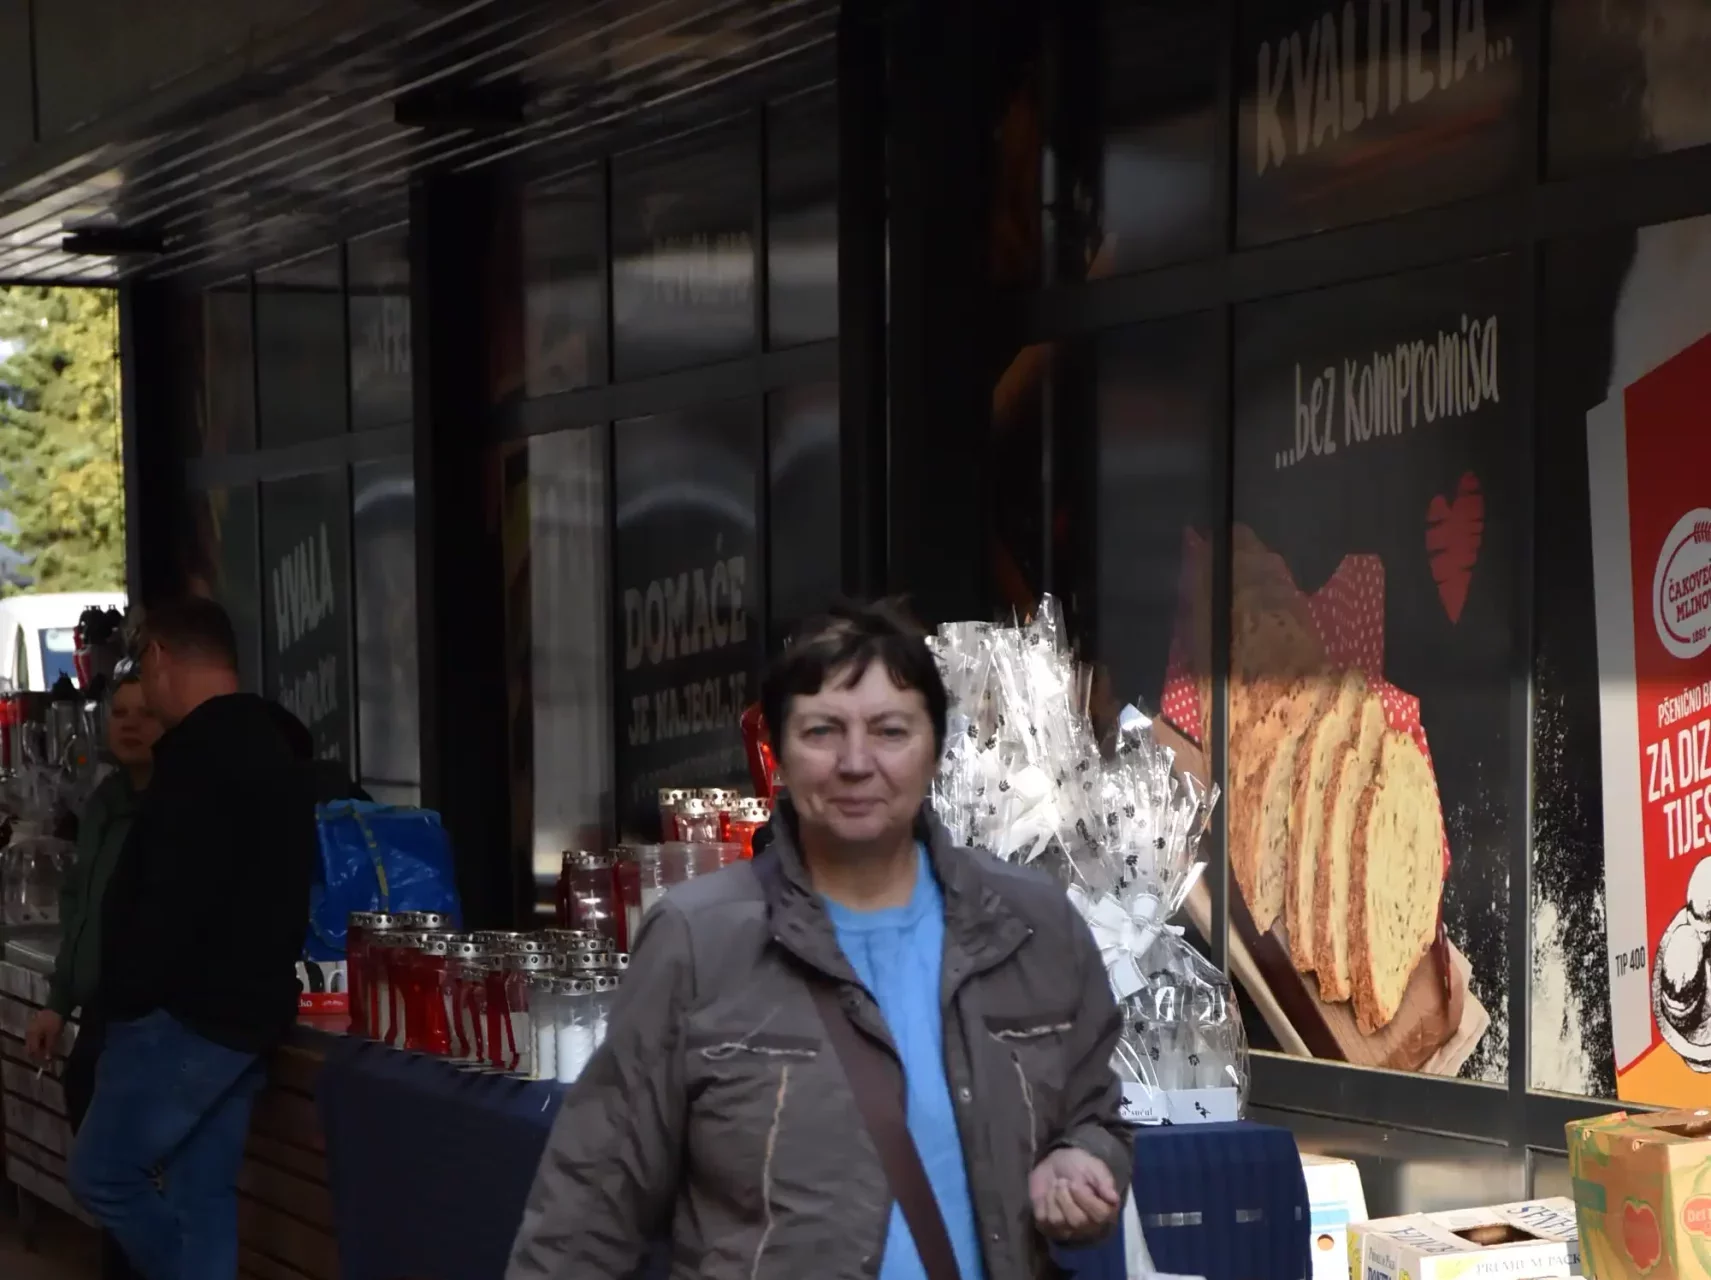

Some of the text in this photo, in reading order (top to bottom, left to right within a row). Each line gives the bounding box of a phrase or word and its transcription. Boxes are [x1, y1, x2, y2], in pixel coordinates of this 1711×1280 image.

[624, 531, 748, 670] DOMAĆE
[1668, 557, 1711, 603] ČAKOVE
[628, 694, 650, 746] JE
[1658, 687, 1702, 728] PŠENIČNO
[1646, 737, 1675, 803] ZA
[1615, 945, 1645, 977] TIP 400
